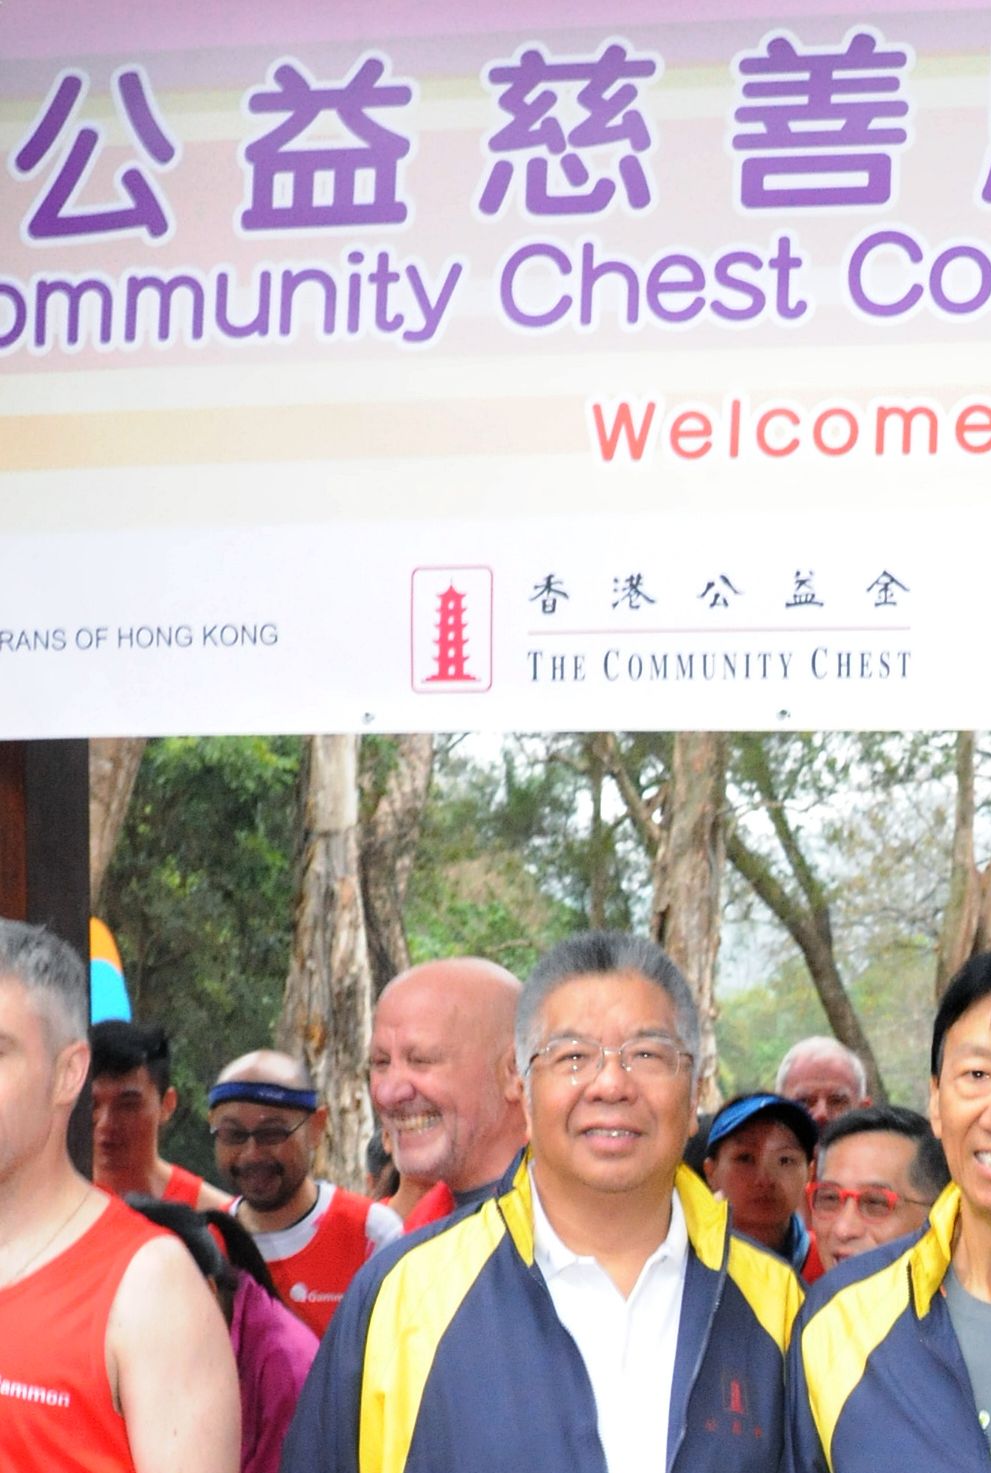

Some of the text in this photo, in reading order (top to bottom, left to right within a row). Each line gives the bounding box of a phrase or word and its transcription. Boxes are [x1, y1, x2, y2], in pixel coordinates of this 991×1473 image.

[498, 236, 808, 328] Chest
[528, 569, 911, 615] 香港公益金
[0, 623, 279, 652] RANS OF HONG KONG
[0, 1378, 71, 1408] ammon
